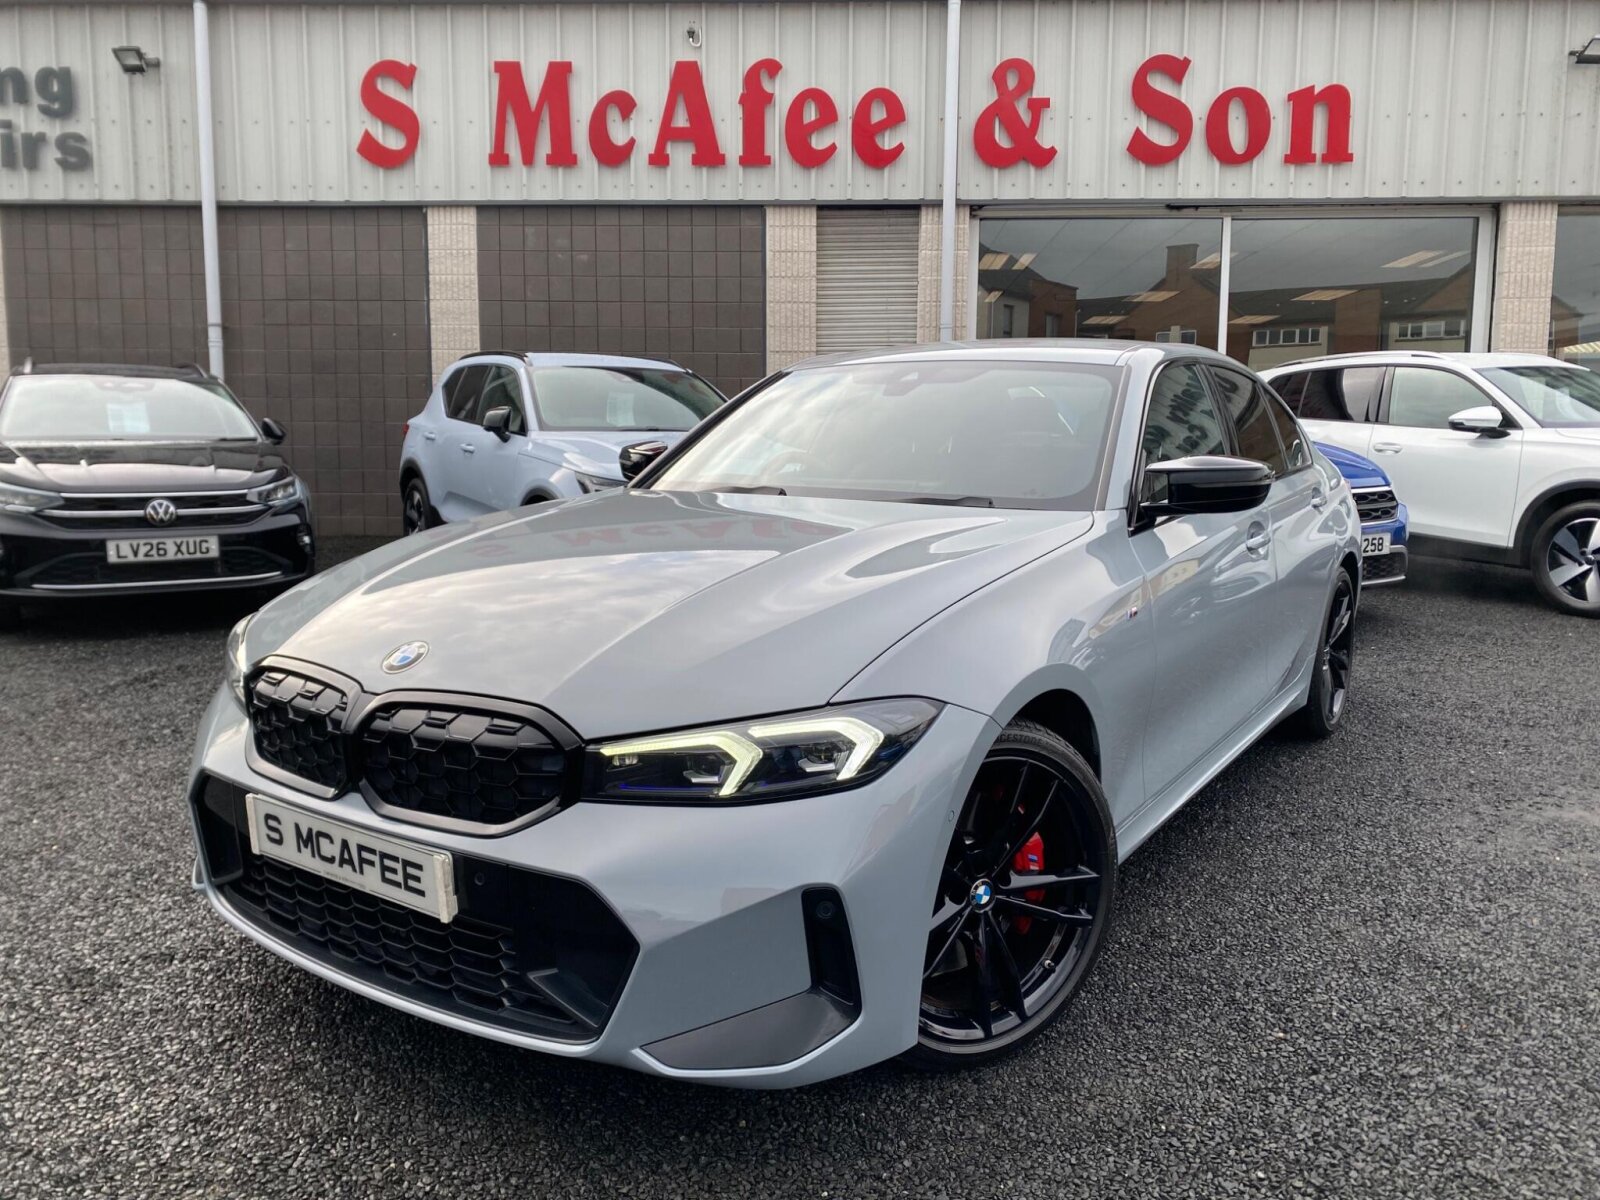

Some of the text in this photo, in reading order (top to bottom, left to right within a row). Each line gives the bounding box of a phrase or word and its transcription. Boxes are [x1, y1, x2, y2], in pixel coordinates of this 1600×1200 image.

[357, 54, 1353, 168] S McAfee & Son
[116, 540, 210, 559] LV26 XUG
[1362, 536, 1384, 554] 258
[264, 812, 426, 898] S MCAFEE
